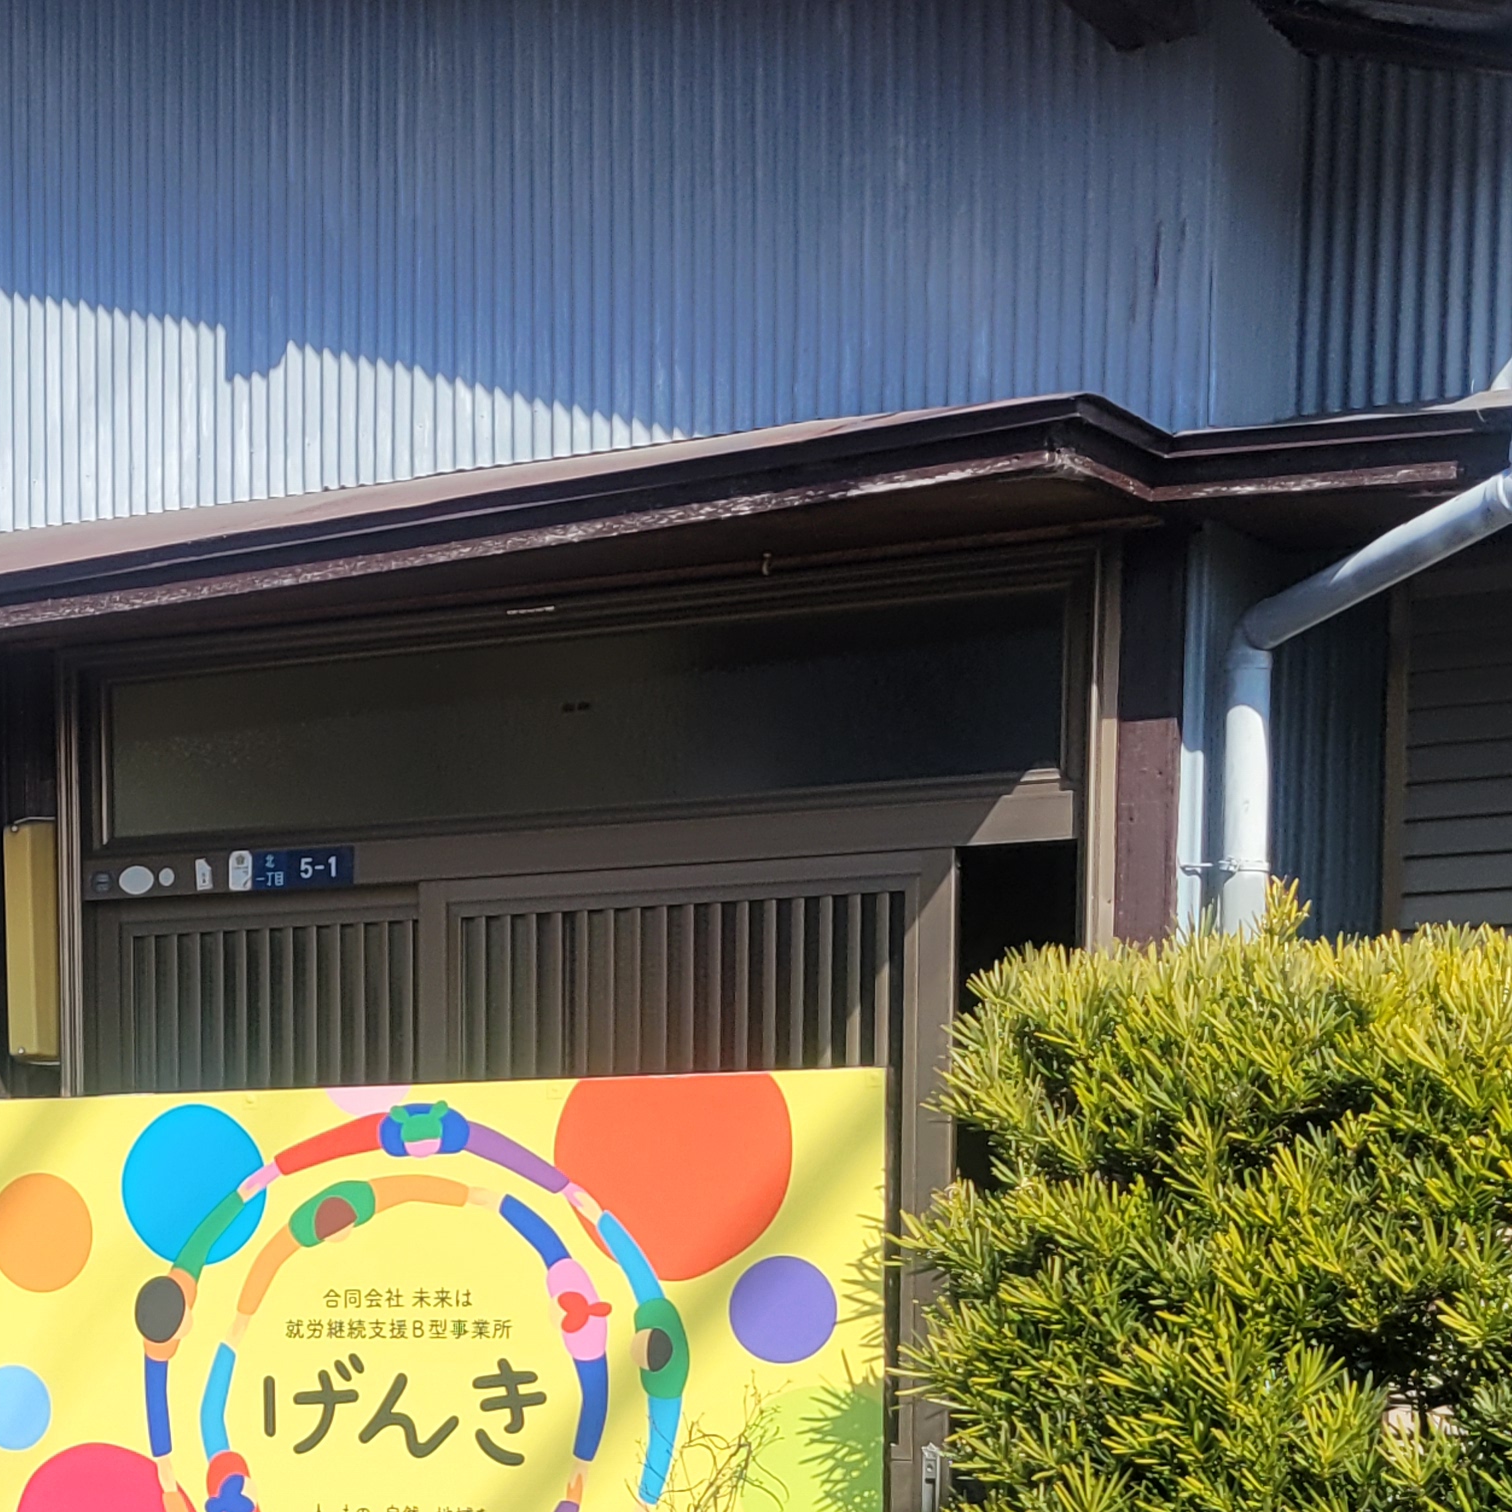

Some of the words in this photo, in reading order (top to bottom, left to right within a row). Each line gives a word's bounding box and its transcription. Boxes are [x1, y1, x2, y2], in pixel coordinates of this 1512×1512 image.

[299, 855, 338, 880] 5-1
[255, 871, 285, 888] 一丁目
[322, 1288, 405, 1309] 合同会社
[411, 1287, 473, 1309] 未来は
[285, 1318, 513, 1340] 就労継続支援B型事業所
[263, 1353, 547, 1466] げんき
